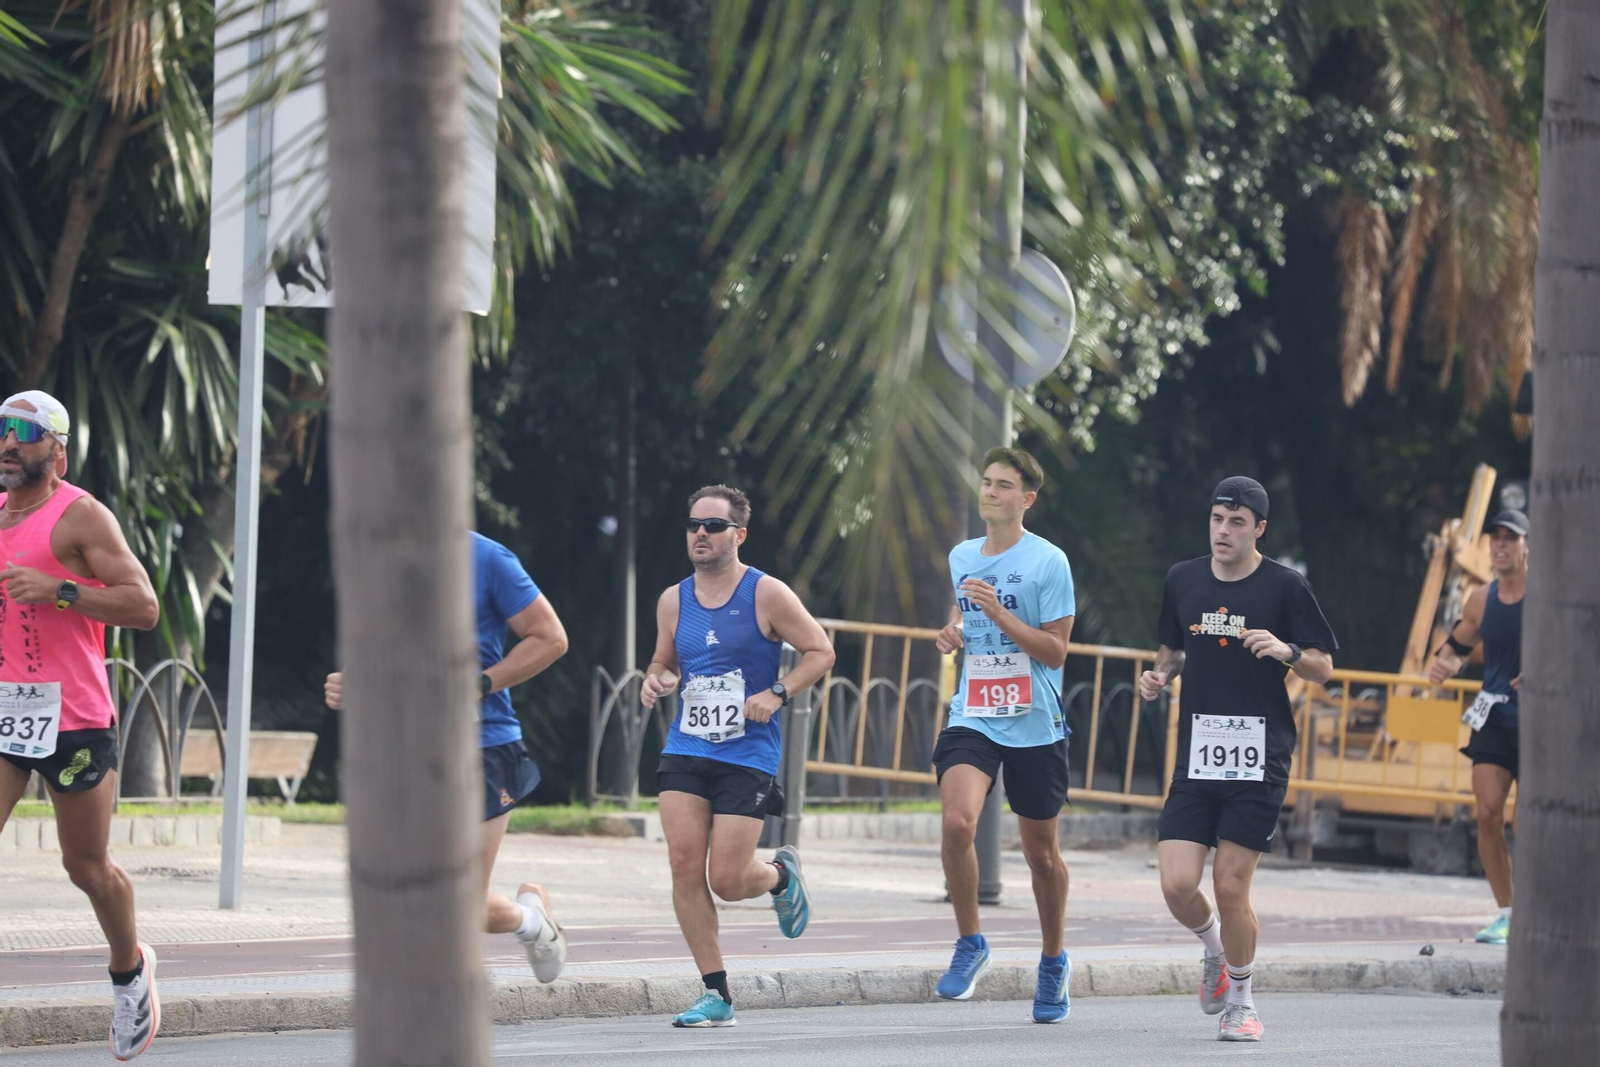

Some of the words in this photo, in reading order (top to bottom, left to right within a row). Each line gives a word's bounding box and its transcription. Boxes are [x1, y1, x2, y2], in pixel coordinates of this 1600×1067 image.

[1202, 612, 1228, 625] KEEP
[1229, 615, 1246, 627] ON
[980, 683, 1020, 707] 198
[688, 704, 739, 727] 5812
[1198, 744, 1259, 768] 1919
